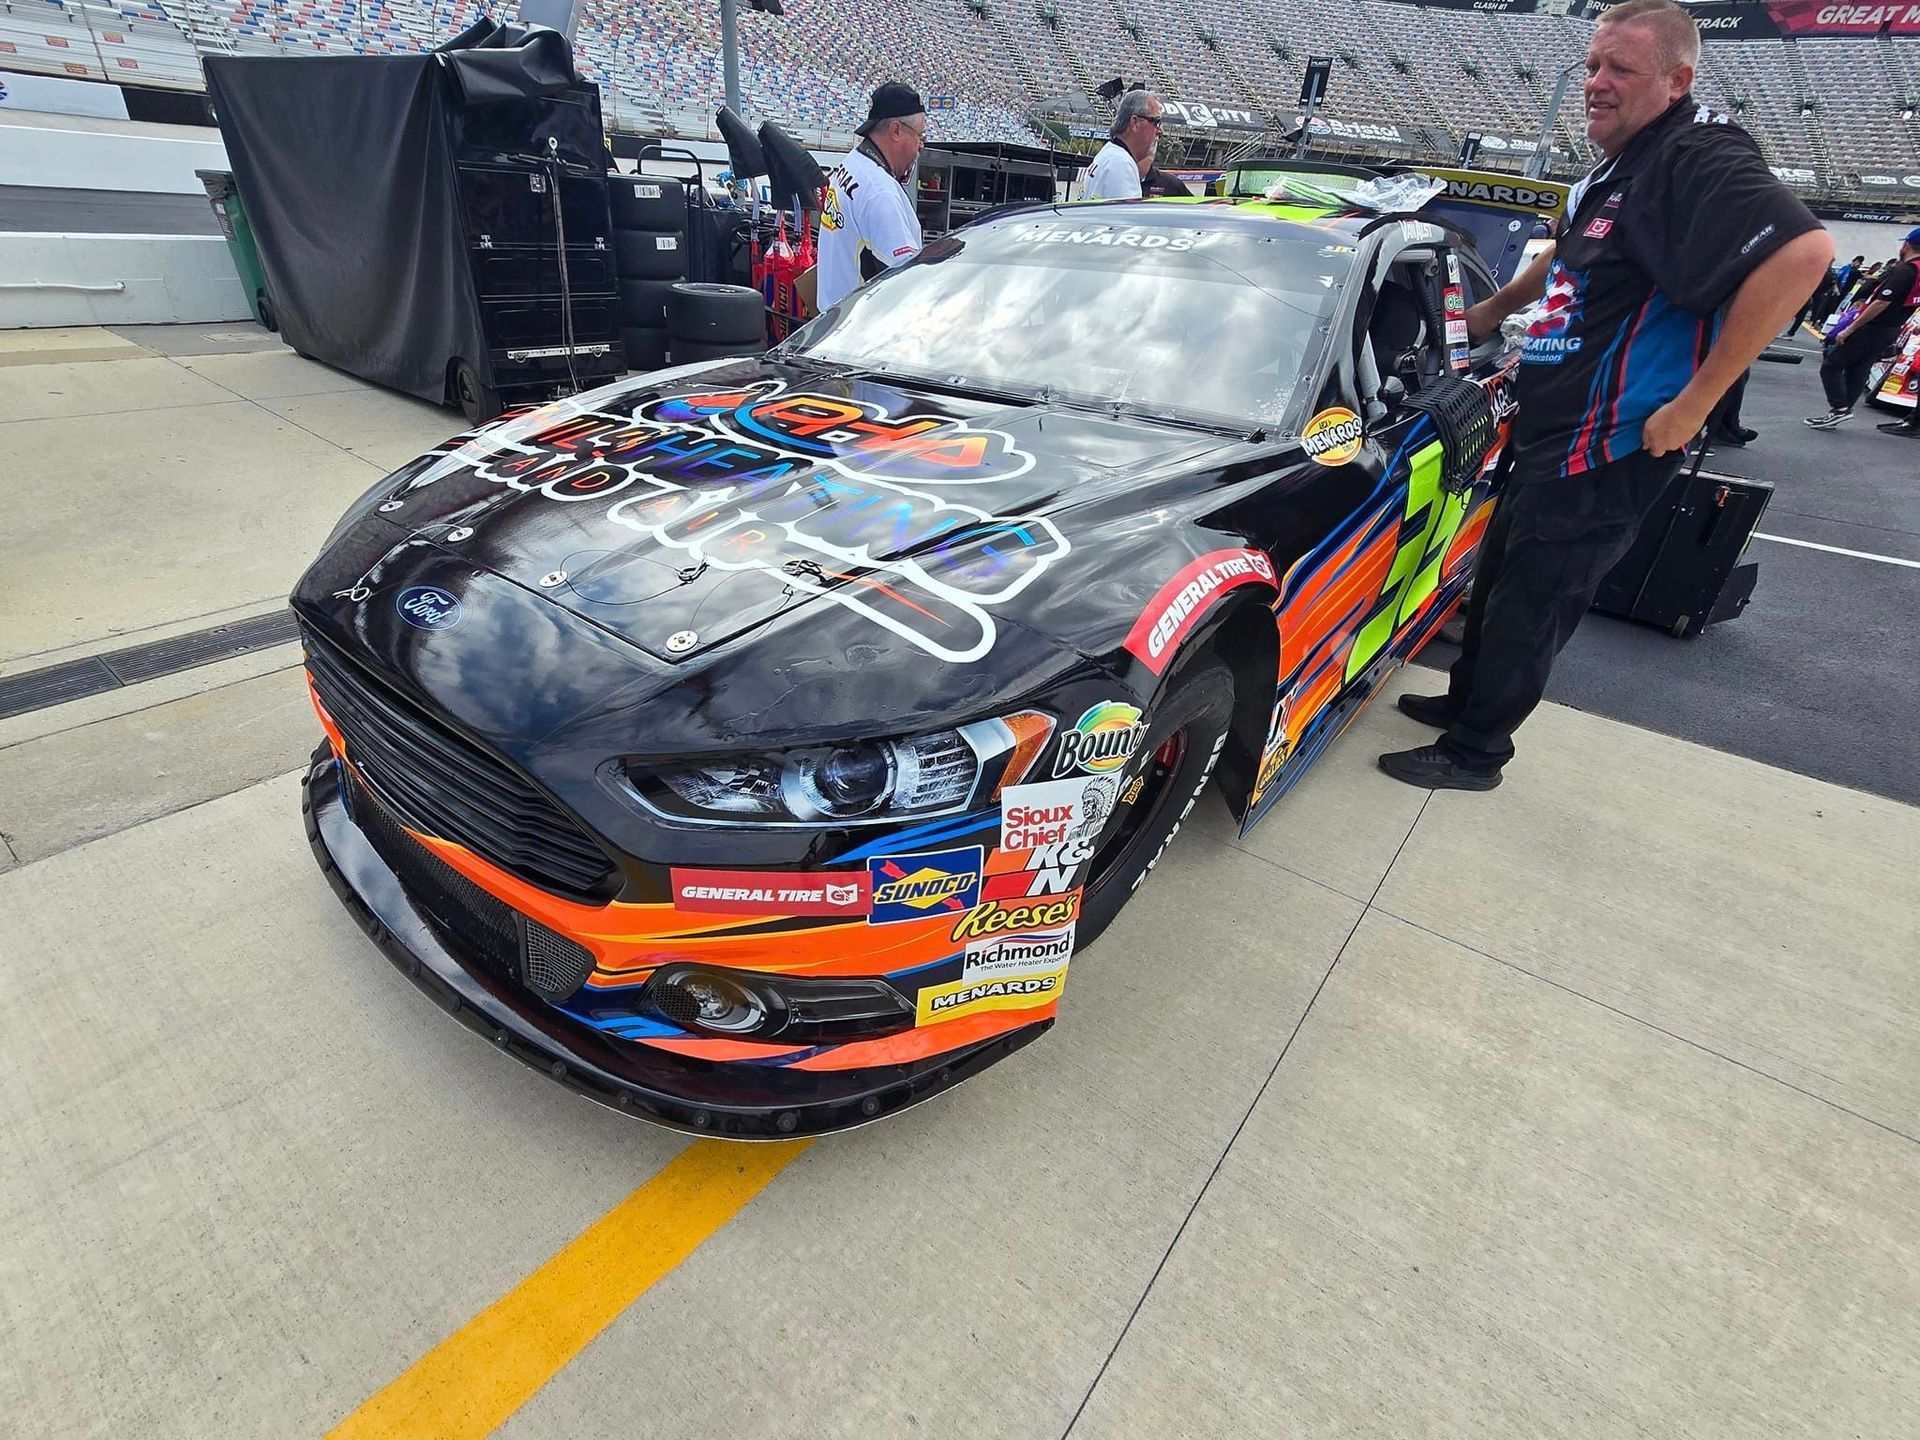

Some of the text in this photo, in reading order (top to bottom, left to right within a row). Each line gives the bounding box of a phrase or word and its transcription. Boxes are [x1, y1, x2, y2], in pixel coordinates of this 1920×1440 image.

[1473, 2, 1495, 10] CLASH
[1816, 6, 1903, 25] GREAT
[1212, 108, 1250, 122] CITY
[1328, 120, 1400, 137] Bristol
[1843, 213, 1891, 221] CHEVROLET
[1016, 231, 1195, 251] MENARDS
[1300, 417, 1362, 457] MENARDS
[503, 456, 766, 557] AND AIR
[623, 435, 1035, 581] HEATING
[404, 591, 453, 624] Ford
[1148, 568, 1224, 658] GENERAL
[1213, 557, 1254, 580] TIRE
[1005, 804, 1074, 829] Sioux
[1004, 823, 1067, 850] Chief
[681, 886, 774, 902] GENERAL
[776, 889, 824, 902] TIRE
[878, 874, 975, 904] SUNOCO
[1026, 865, 1079, 897] N
[951, 894, 1079, 942] Reese's
[965, 930, 1071, 970] Richmond
[980, 964, 994, 973] The
[995, 959, 1017, 970] Water
[1018, 956, 1042, 968] Heater
[931, 976, 1058, 1012] MENARDS
